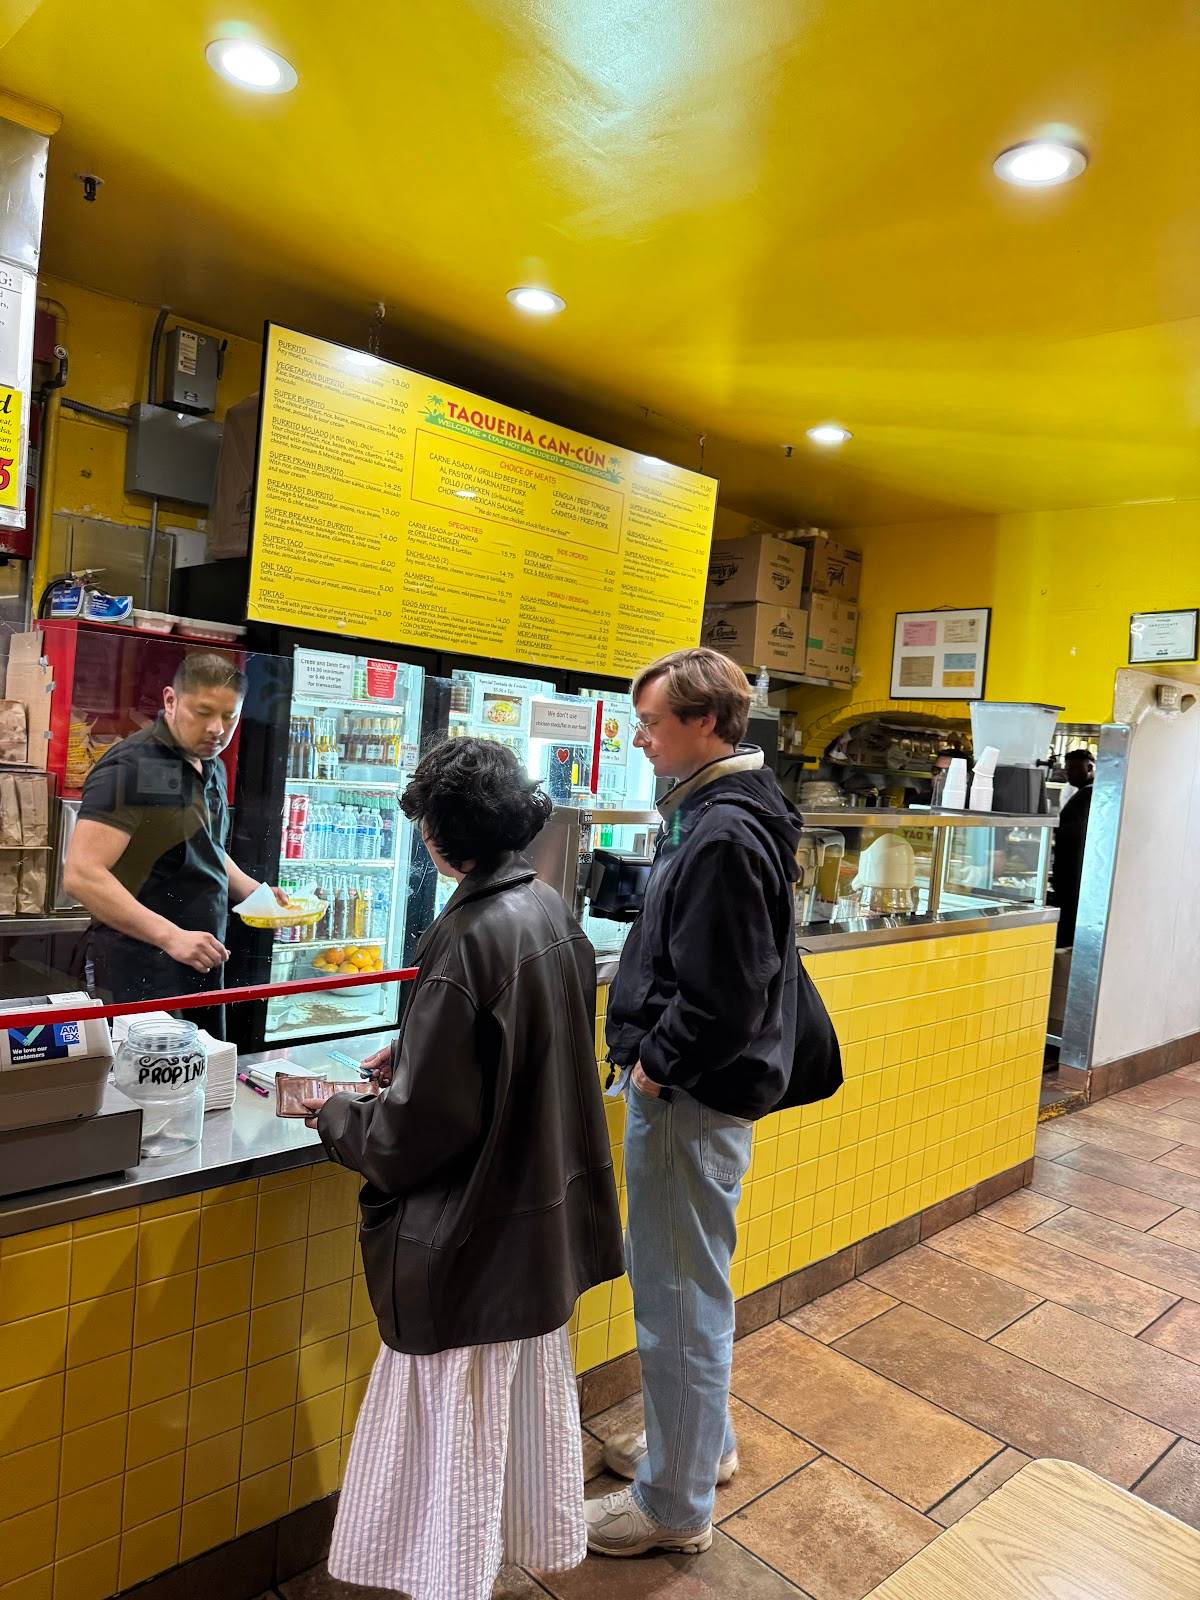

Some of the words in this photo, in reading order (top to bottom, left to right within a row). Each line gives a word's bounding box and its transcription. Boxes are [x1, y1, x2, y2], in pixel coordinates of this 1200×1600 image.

[278, 339, 306, 354] BURRITO
[391, 378, 409, 389] 13.00
[275, 389, 295, 401] SUPER
[297, 395, 324, 409] BURRITO
[388, 423, 406, 434] 14.00
[272, 417, 300, 430] BURRITO
[302, 425, 327, 438] MOJADO
[386, 449, 403, 459] 14.25
[439, 418, 480, 436] WELCOME
[505, 440, 518, 449] NOT
[447, 401, 534, 445] TAQUERIA
[538, 430, 604, 468] CAN-CÚN
[269, 451, 289, 462] SUPER
[292, 457, 315, 469] PRAWN
[317, 464, 343, 476] BURRITO
[383, 482, 401, 491] 14.25
[429, 453, 451, 464] CARNE
[452, 459, 473, 471] ASADA
[479, 467, 502, 479] GRILLED
[503, 475, 517, 484] BEEF
[519, 479, 536, 489] STEAK
[440, 477, 459, 487] POLLO
[465, 484, 489, 496] CHICKEN
[448, 469, 472, 480] PASTOR
[477, 477, 509, 491] MARINATED
[511, 487, 525, 496] PORK
[500, 461, 524, 474] CHOICE
[534, 471, 556, 484] MEATS
[267, 479, 305, 493] BREAKFAST
[307, 488, 333, 500] BURRITO
[382, 507, 399, 516] 13.00
[437, 486, 465, 499] CHOR
[497, 502, 524, 515] SAUSAGE
[265, 506, 287, 517] SUPER
[289, 512, 325, 525] BREAKFAST
[327, 521, 353, 532] BURRITO
[380, 533, 397, 542] 14.00
[408, 521, 425, 530] CARNE
[428, 526, 445, 534] ASADA
[454, 532, 478, 542] CARNITAS
[415, 531, 436, 540] GRILLED
[438, 536, 458, 545] CHICKEN
[263, 534, 284, 544] SUPER
[286, 539, 303, 548] TACO
[381, 559, 395, 567] 6.00
[261, 561, 273, 569] ONE
[276, 564, 292, 573] TACO
[380, 584, 393, 592] 5.00
[259, 589, 284, 598] TORTAS
[60, 1026, 78, 1035] AM
[64, 1034, 80, 1042] EX
[13, 1052, 45, 1060] customers
